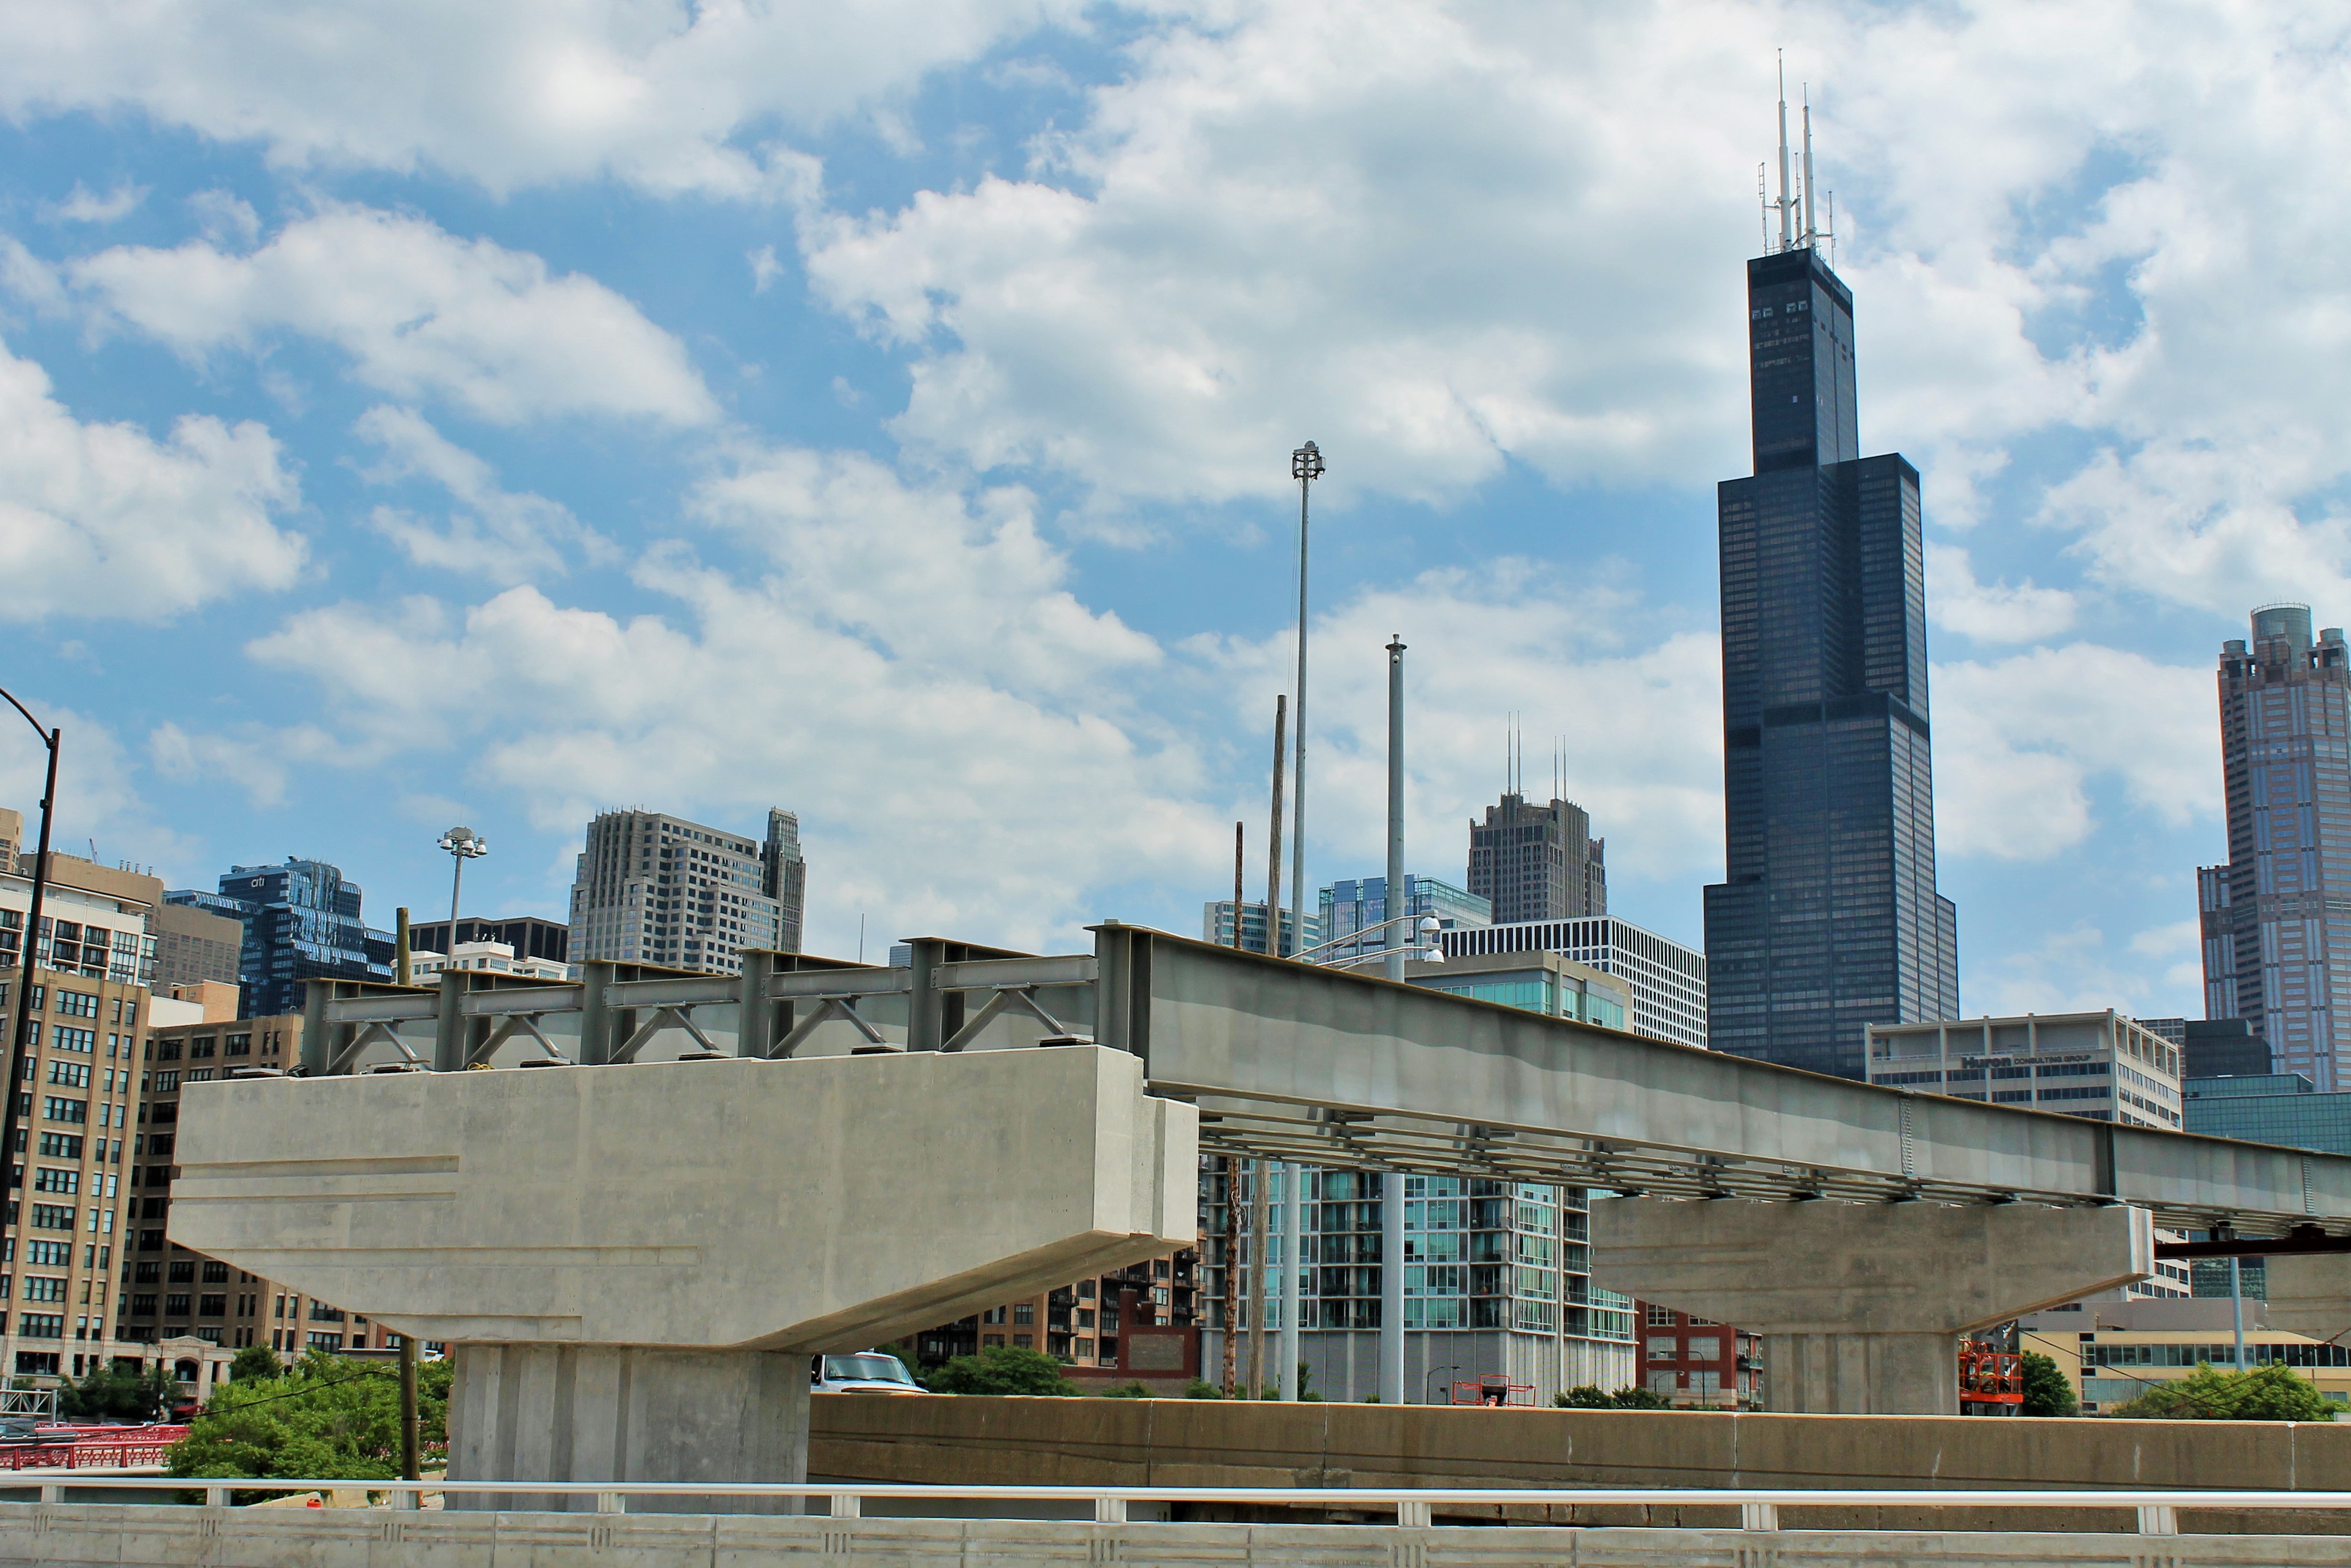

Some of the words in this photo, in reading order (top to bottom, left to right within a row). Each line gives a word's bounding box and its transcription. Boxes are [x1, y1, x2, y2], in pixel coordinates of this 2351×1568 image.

[251, 876, 265, 887] citi
[1961, 1057, 2011, 1069] Huron
[2014, 1056, 2062, 1065] CONSULTING
[2064, 1054, 2091, 1062] GROUP
